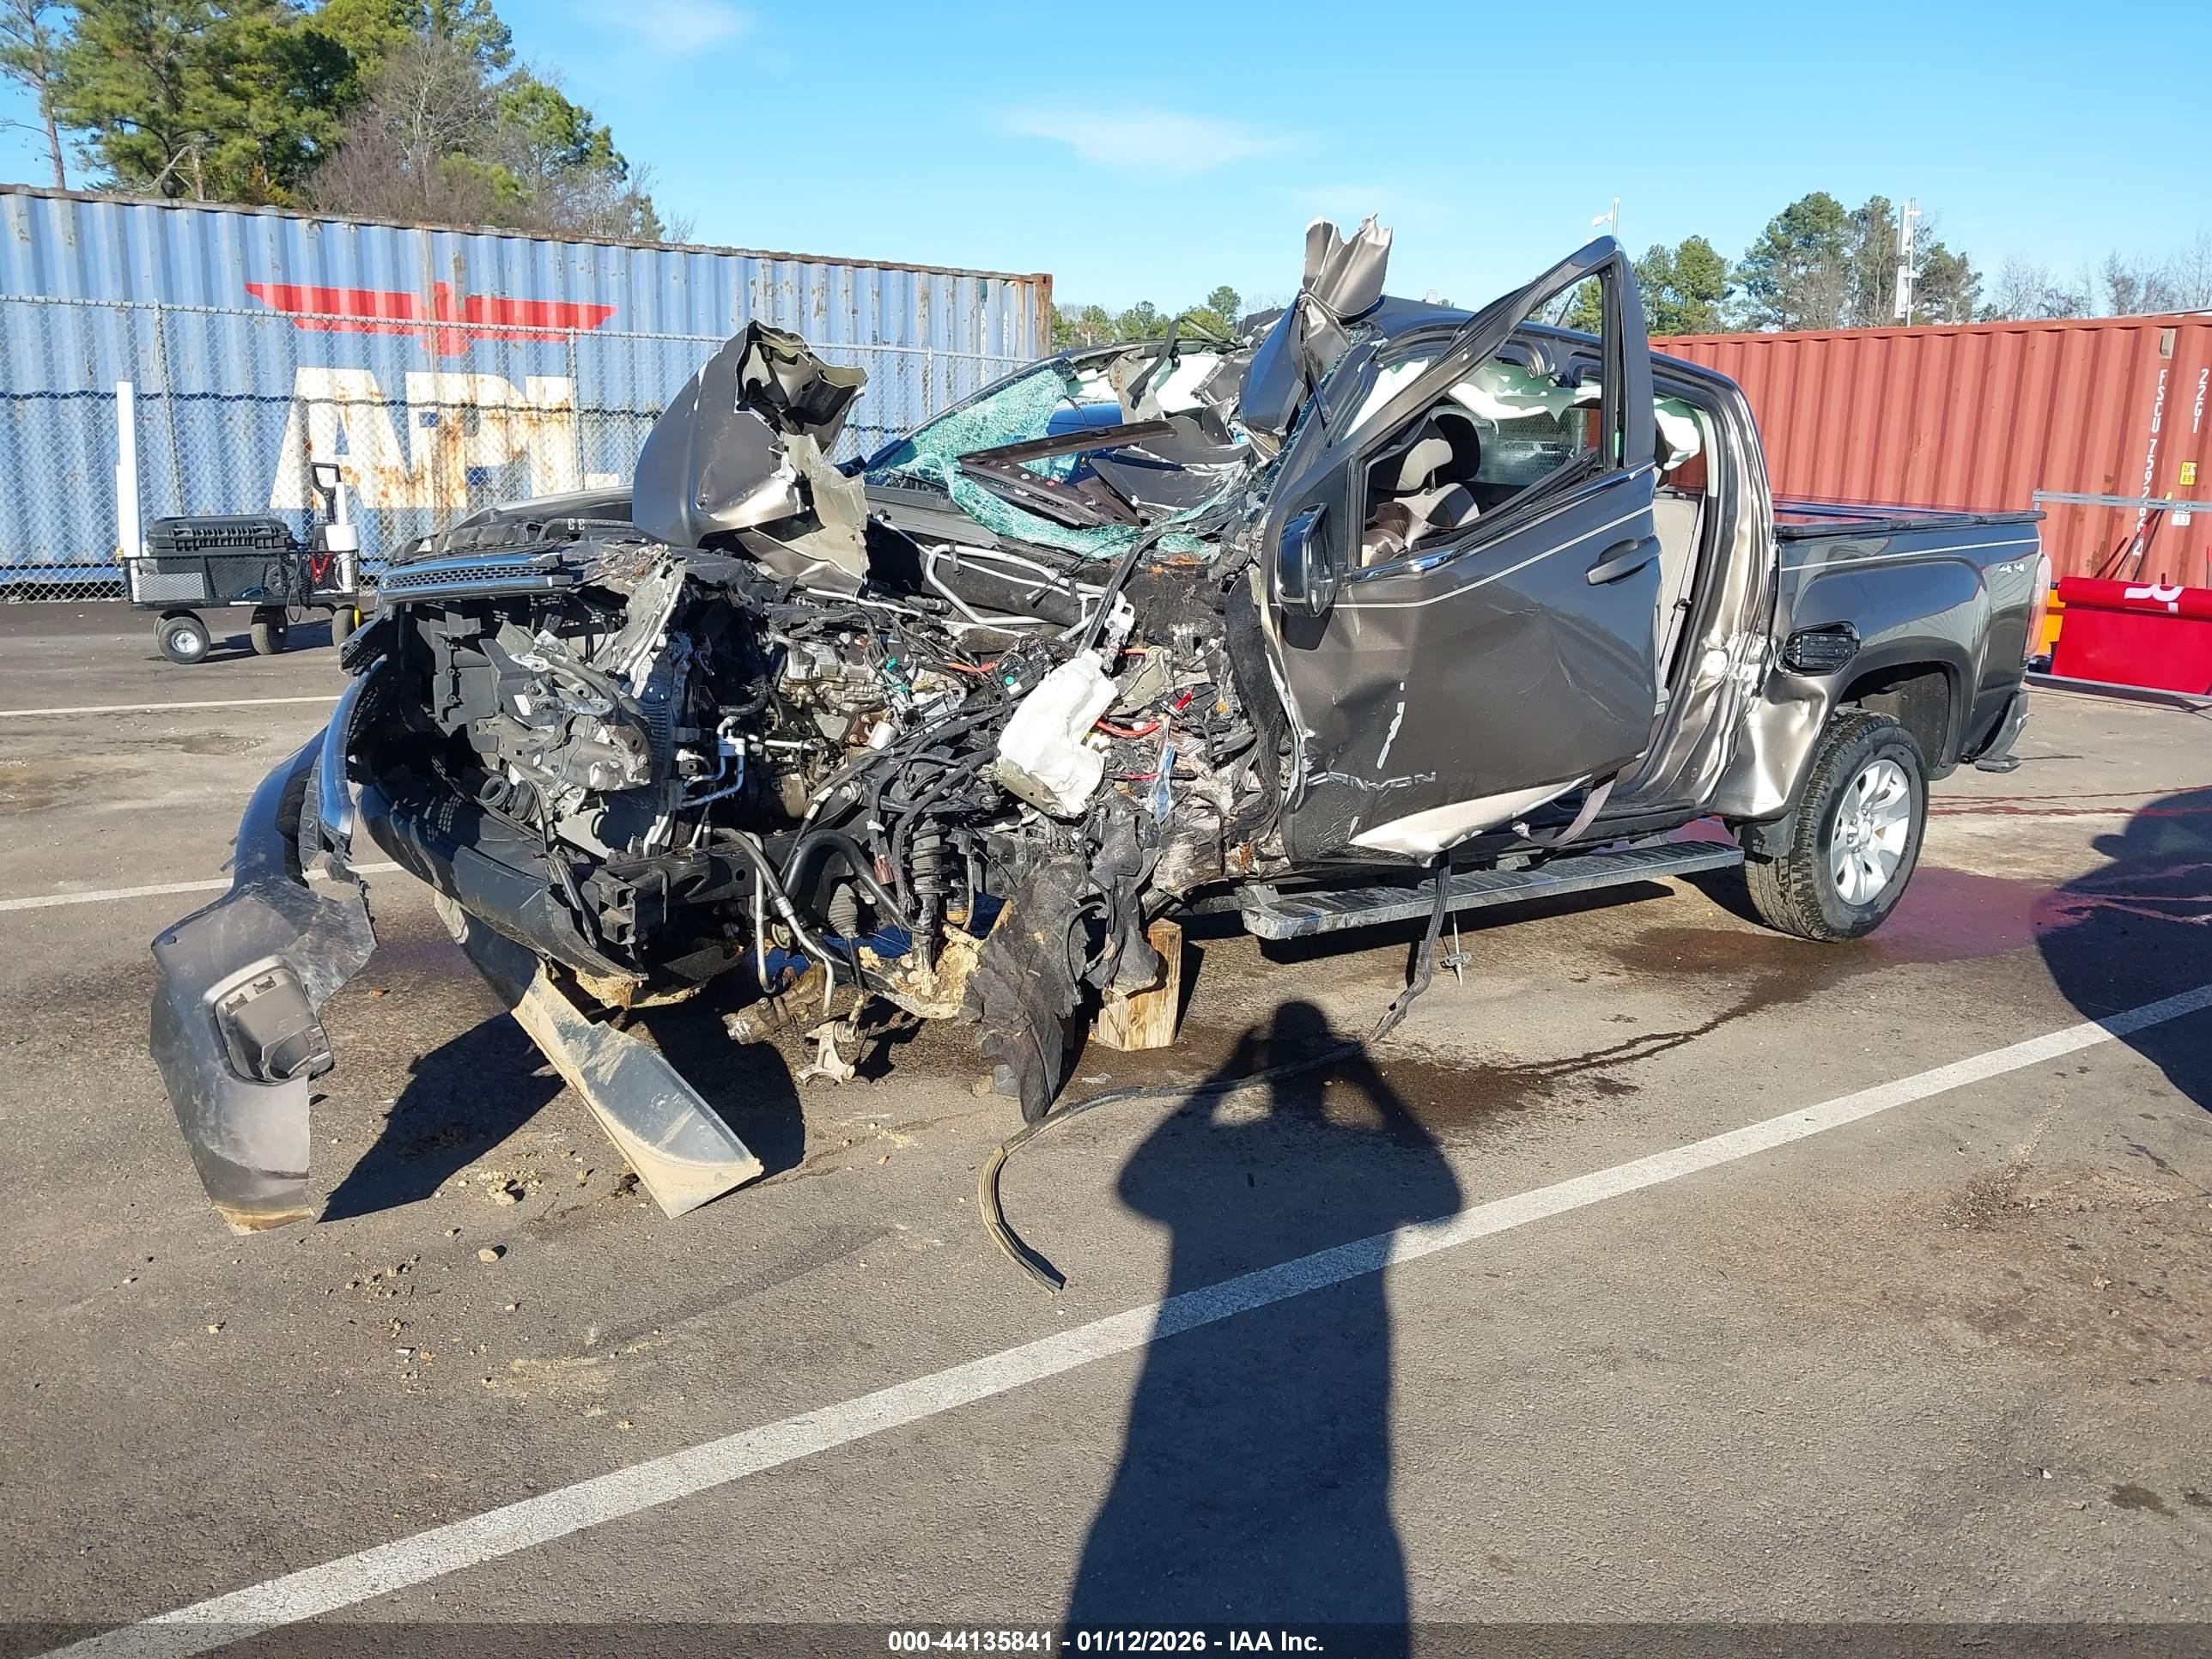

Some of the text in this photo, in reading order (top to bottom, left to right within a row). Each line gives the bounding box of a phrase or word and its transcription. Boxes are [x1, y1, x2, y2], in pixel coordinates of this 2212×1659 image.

[2151, 368, 2168, 434] FSCU
[2192, 368, 2209, 434] 22G1
[269, 367, 620, 509] APL
[1307, 771, 1437, 792] CANYON
